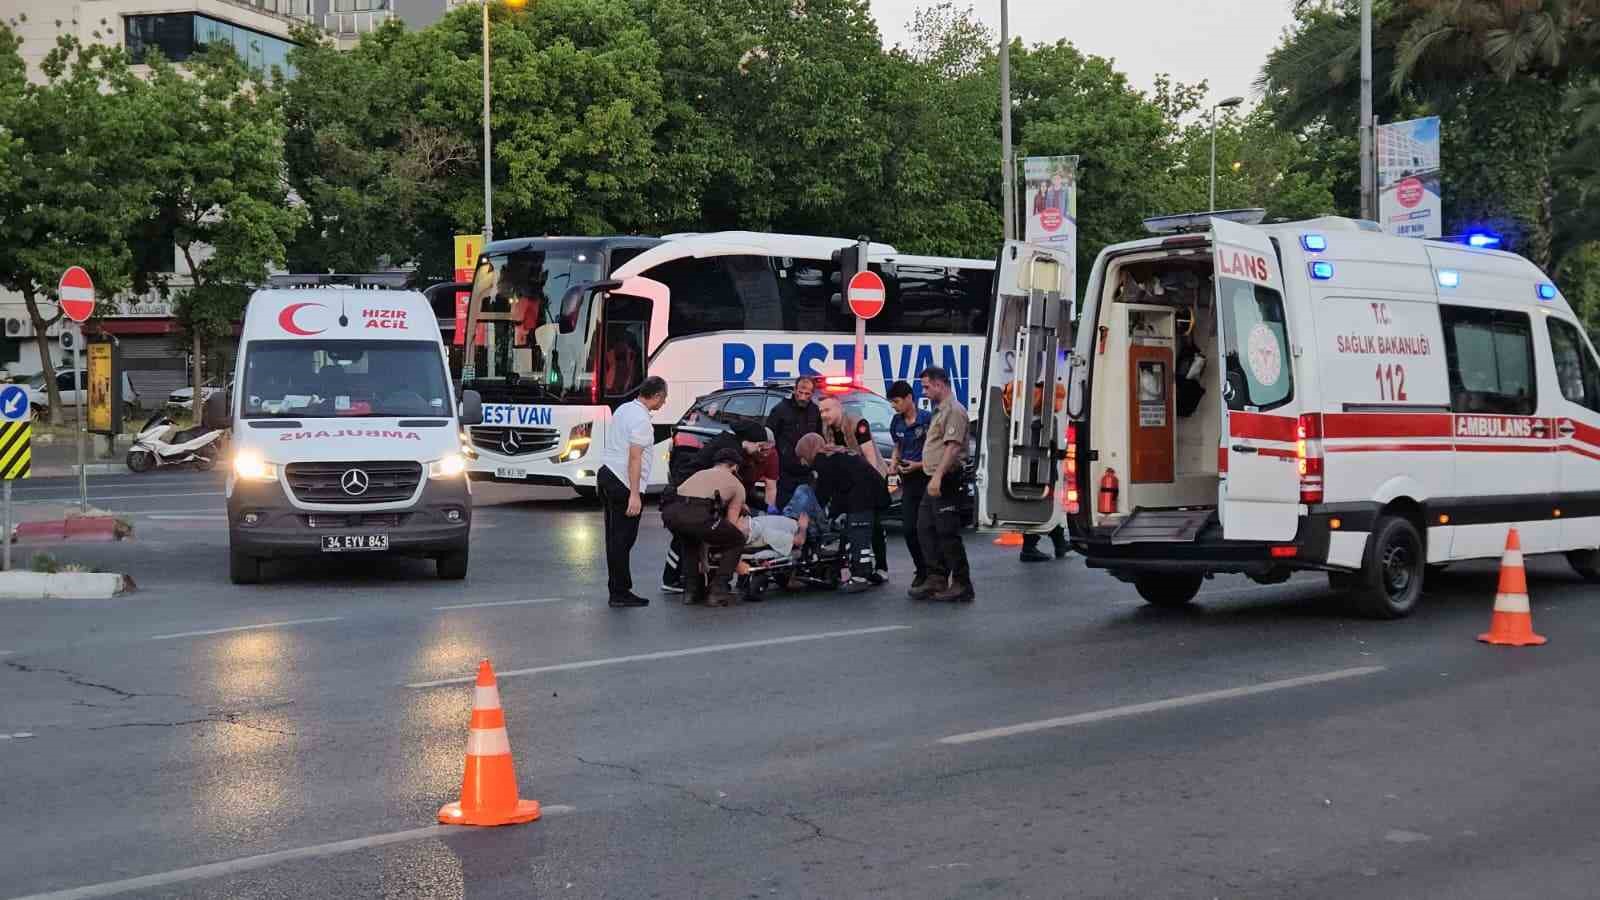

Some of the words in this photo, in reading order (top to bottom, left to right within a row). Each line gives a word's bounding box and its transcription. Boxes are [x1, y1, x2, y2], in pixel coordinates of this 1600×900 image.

[1218, 249, 1268, 281] LANS
[362, 309, 408, 319] HIZIR
[1336, 331, 1376, 353] SAĞLIK
[1377, 333, 1431, 355] BAKANLIĞI
[878, 344, 970, 411] VAN
[1375, 363, 1408, 401] 112
[481, 405, 515, 424] EST
[518, 407, 552, 425] VAN
[1457, 416, 1532, 437] AMBULANS
[328, 536, 341, 548] 34
[345, 535, 365, 547] EYV
[368, 535, 387, 547] 843
